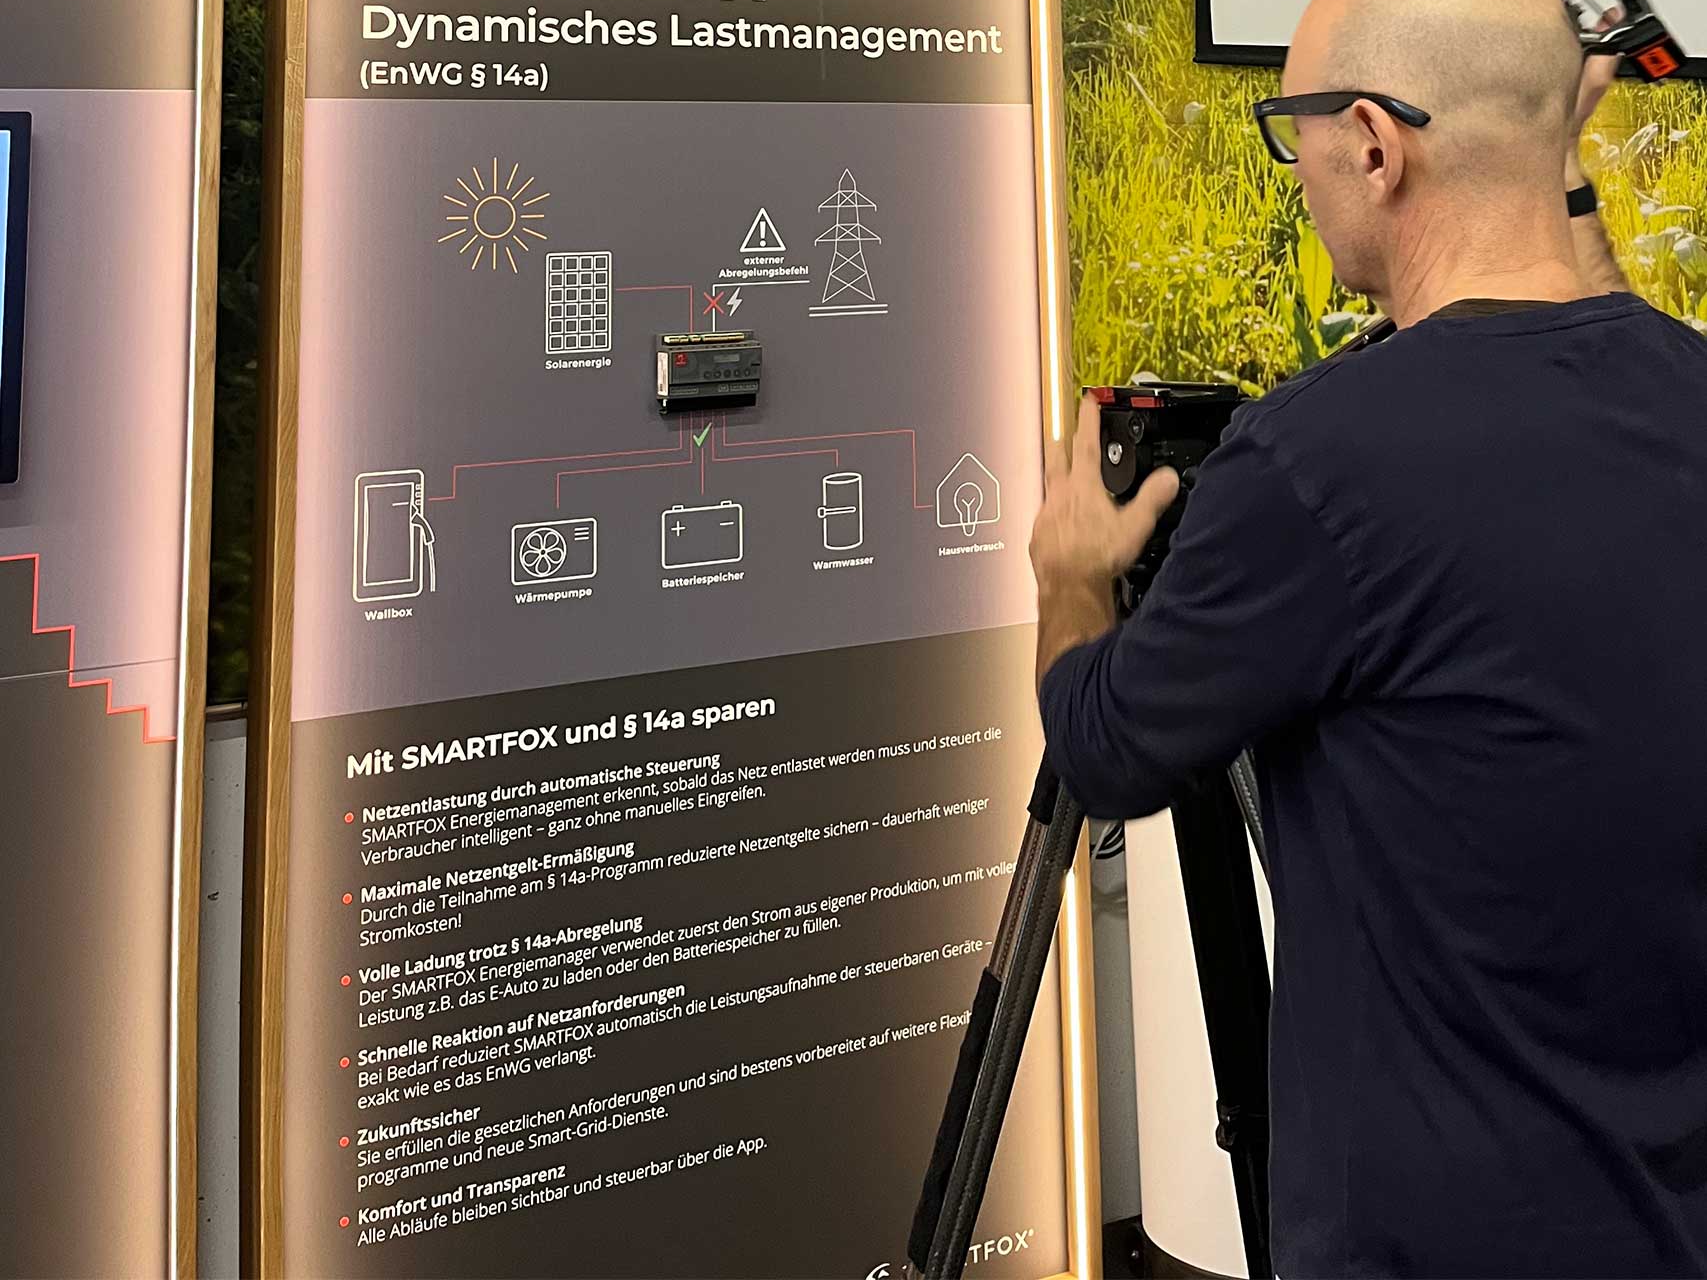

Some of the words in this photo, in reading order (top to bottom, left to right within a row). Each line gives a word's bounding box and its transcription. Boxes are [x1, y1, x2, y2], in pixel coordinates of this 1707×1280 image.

[363, 5, 656, 49] Dynamisches
[670, 15, 1002, 58] Lastmanagement
[360, 61, 462, 90] (EnWG
[471, 63, 485, 88] §
[493, 62, 549, 91] 14a)
[719, 265, 808, 280] Abregelungsbefehl
[744, 254, 784, 266] externer
[545, 357, 612, 371] Solarenergie
[813, 555, 874, 570] Warmwasser
[938, 540, 1004, 556] Hausverbrauch
[515, 586, 592, 606] Wärmepumpe
[662, 570, 744, 590] Batteriespeicher
[365, 606, 412, 622] Wallbox
[346, 750, 394, 778] Mit
[400, 725, 558, 769] SMARTFOX
[564, 715, 616, 744] und
[622, 713, 637, 738] §
[642, 708, 685, 733] 14a
[691, 698, 775, 729] sparen
[361, 816, 446, 845] SMARTFOX
[450, 792, 600, 829] Energiemanagement
[602, 782, 660, 803] erkennt,
[662, 772, 707, 794] sobald
[710, 770, 734, 785] das
[737, 765, 768, 781] Netz
[770, 755, 826, 776] entlastet
[827, 747, 874, 766] werden
[877, 742, 910, 758] muss
[362, 791, 487, 823] Netzentlastung
[490, 780, 536, 802] durch
[539, 765, 642, 793] automatische
[645, 753, 720, 776] Steuerung
[360, 838, 458, 865] Verbraucher
[460, 824, 532, 848] intelligent
[547, 816, 582, 837] ganz
[584, 809, 621, 827] ohne
[624, 796, 694, 819] manuelles
[697, 784, 766, 808] Eingreifen.
[360, 901, 407, 925] Durch
[411, 897, 435, 915] die
[438, 884, 516, 909] Teilnahme
[519, 879, 543, 894] am
[560, 857, 664, 886] 14a-Programm
[666, 843, 736, 867] reduzierte
[738, 827, 820, 853] Netzentgelte
[822, 819, 868, 838] sichern
[360, 874, 441, 903] Maximale
[445, 842, 634, 887] Netzentgelt-Ermäßigung
[358, 988, 388, 1006] Der
[391, 968, 476, 999] SMARTFOX
[479, 946, 598, 981] Energiemanager
[600, 929, 674, 956] verwendet
[677, 920, 720, 940] zuerst
[722, 915, 748, 931] den
[750, 906, 791, 925] Strom
[793, 901, 817, 916] aus
[819, 891, 867, 913] eigener
[870, 877, 940, 901] Produktion,
[358, 962, 400, 984] Volle
[404, 951, 465, 975] Ladung
[468, 943, 507, 962] trotz
[523, 916, 643, 950] 14a-Abregelung
[359, 912, 462, 946] Stromkosten!
[358, 1002, 424, 1027] Leistung
[427, 994, 455, 1014] z.B.
[458, 989, 486, 1007] das
[489, 979, 538, 1000] E-Auto
[541, 975, 559, 990] zu
[562, 966, 602, 985] laden
[605, 957, 640, 976] oder
[642, 951, 669, 968] den
[672, 928, 781, 961] Batteriespeicher
[783, 925, 799, 939] zu
[802, 916, 842, 934] füllen.
[357, 1038, 428, 1066] Schnelle
[431, 1024, 503, 1050] Reaktion
[506, 1013, 534, 1034] auf
[536, 984, 685, 1027] Netzanforderungen
[358, 1067, 382, 1088] Bei
[386, 1054, 440, 1081] Bedarf
[442, 1042, 510, 1069] reduziert
[513, 1022, 594, 1054] SMARTFOX
[596, 1003, 682, 1035] automatisch
[684, 999, 706, 1015] die
[710, 971, 837, 1010] Leistungsaufnahme
[839, 965, 862, 981] der
[864, 949, 939, 975] steuerbaren
[941, 939, 983, 958] Geräte
[356, 1149, 380, 1167] Sie
[384, 1136, 443, 1160] erfüllen
[446, 1129, 470, 1146] die
[473, 1109, 564, 1144] gesetzlichen
[567, 1083, 675, 1118] Anforderungen
[678, 1071, 706, 1092] und
[708, 1064, 737, 1085] sind
[740, 1054, 793, 1077] bestens
[794, 1036, 866, 1064] vorbereitet
[357, 1087, 400, 1109] exakt
[402, 1081, 429, 1099] wie
[432, 1077, 451, 1093] es
[454, 1070, 482, 1088] das
[485, 1057, 530, 1081] EnWG
[533, 1045, 597, 1070] verlangt.
[356, 1106, 480, 1145] Zukunftssicher
[357, 1156, 449, 1192] programme
[452, 1144, 482, 1166] und
[486, 1139, 524, 1159] neue
[528, 1106, 669, 1149] Smart-Grid-Dienste.
[356, 1226, 386, 1246] Alle
[388, 1211, 448, 1239] Abläufe
[451, 1200, 507, 1224] bleiben
[510, 1185, 570, 1210] sichtbar
[573, 1173, 602, 1195] und
[604, 1159, 674, 1187] steuerbar
[676, 1150, 710, 1169] über
[712, 1143, 734, 1160] die
[736, 1137, 768, 1155] App.
[358, 1196, 427, 1225] Komfort
[430, 1185, 462, 1208] und
[465, 1165, 566, 1199] Transparenz
